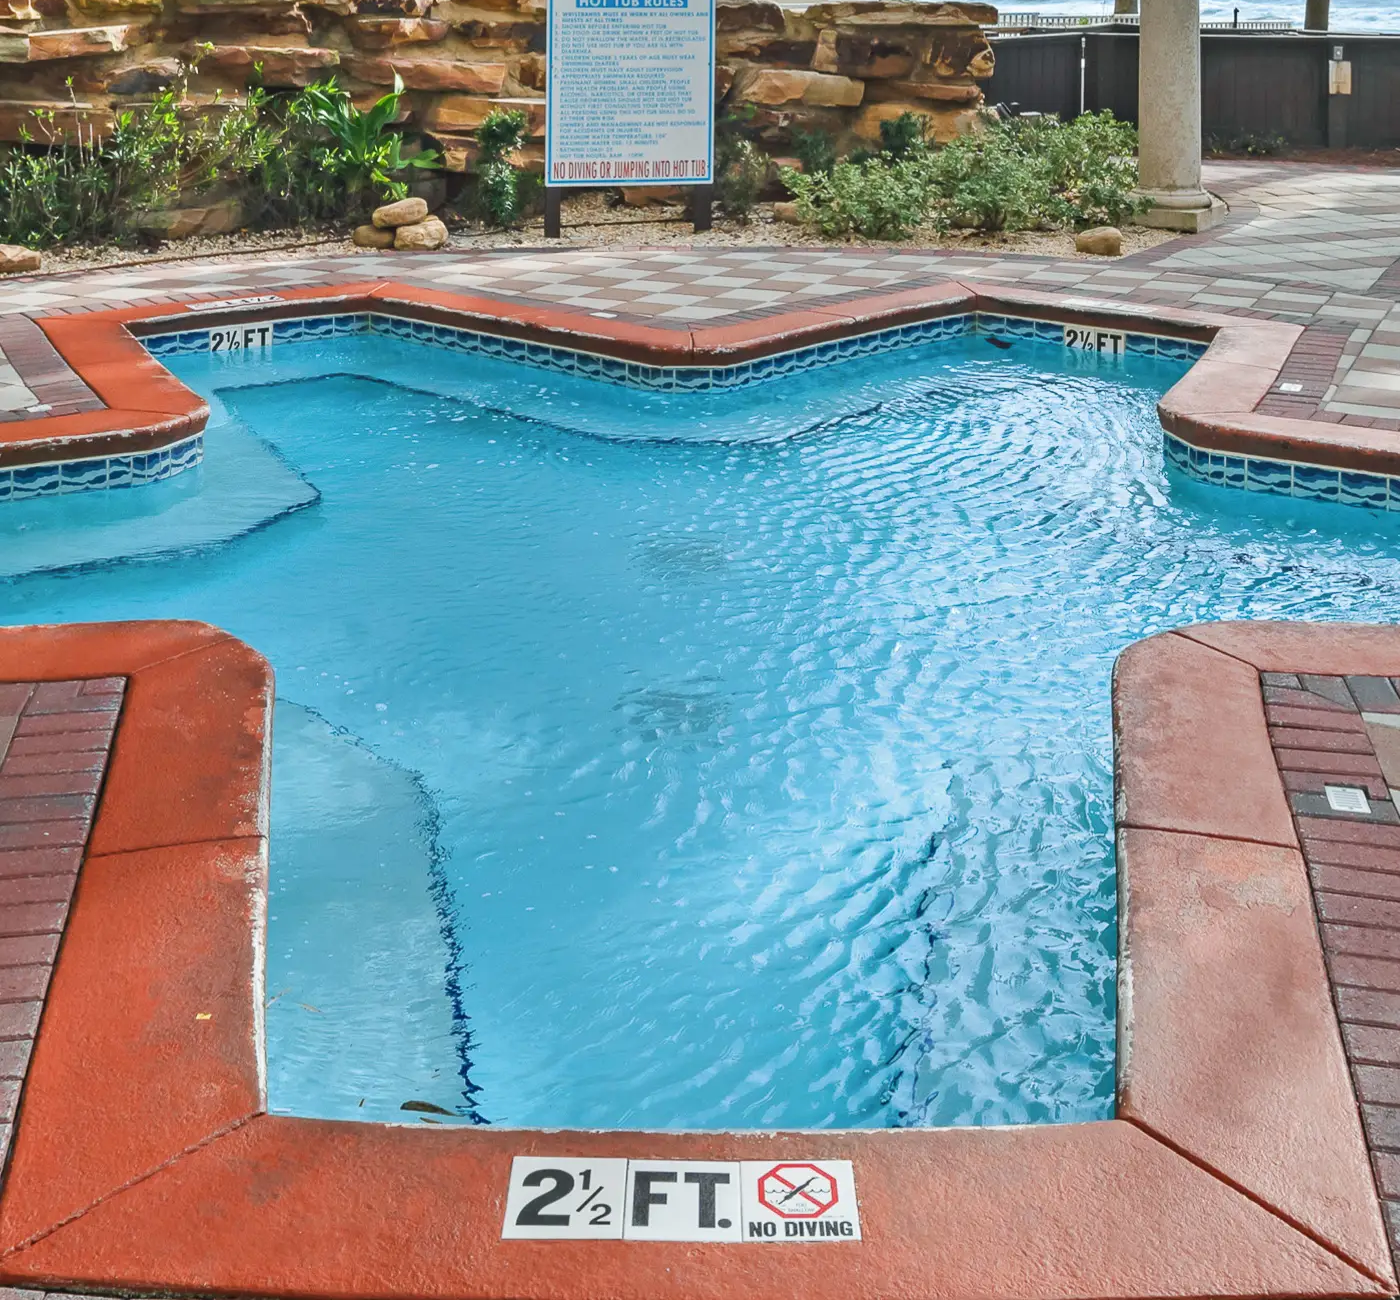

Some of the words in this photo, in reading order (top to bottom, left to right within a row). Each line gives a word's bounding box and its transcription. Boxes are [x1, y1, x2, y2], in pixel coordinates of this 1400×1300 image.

[554, 162, 565, 179] NO
[568, 162, 597, 179] DIVING
[600, 161, 611, 178] OR
[614, 161, 649, 178] JUMPING
[652, 160, 670, 177] INTO
[673, 160, 689, 177] HOT
[692, 160, 706, 176] TUB
[244, 328, 269, 348] FT
[1097, 332, 1122, 354] FT
[632, 1171, 732, 1229] FT.
[749, 1222, 776, 1237] NO
[784, 1221, 854, 1236] DIVING
